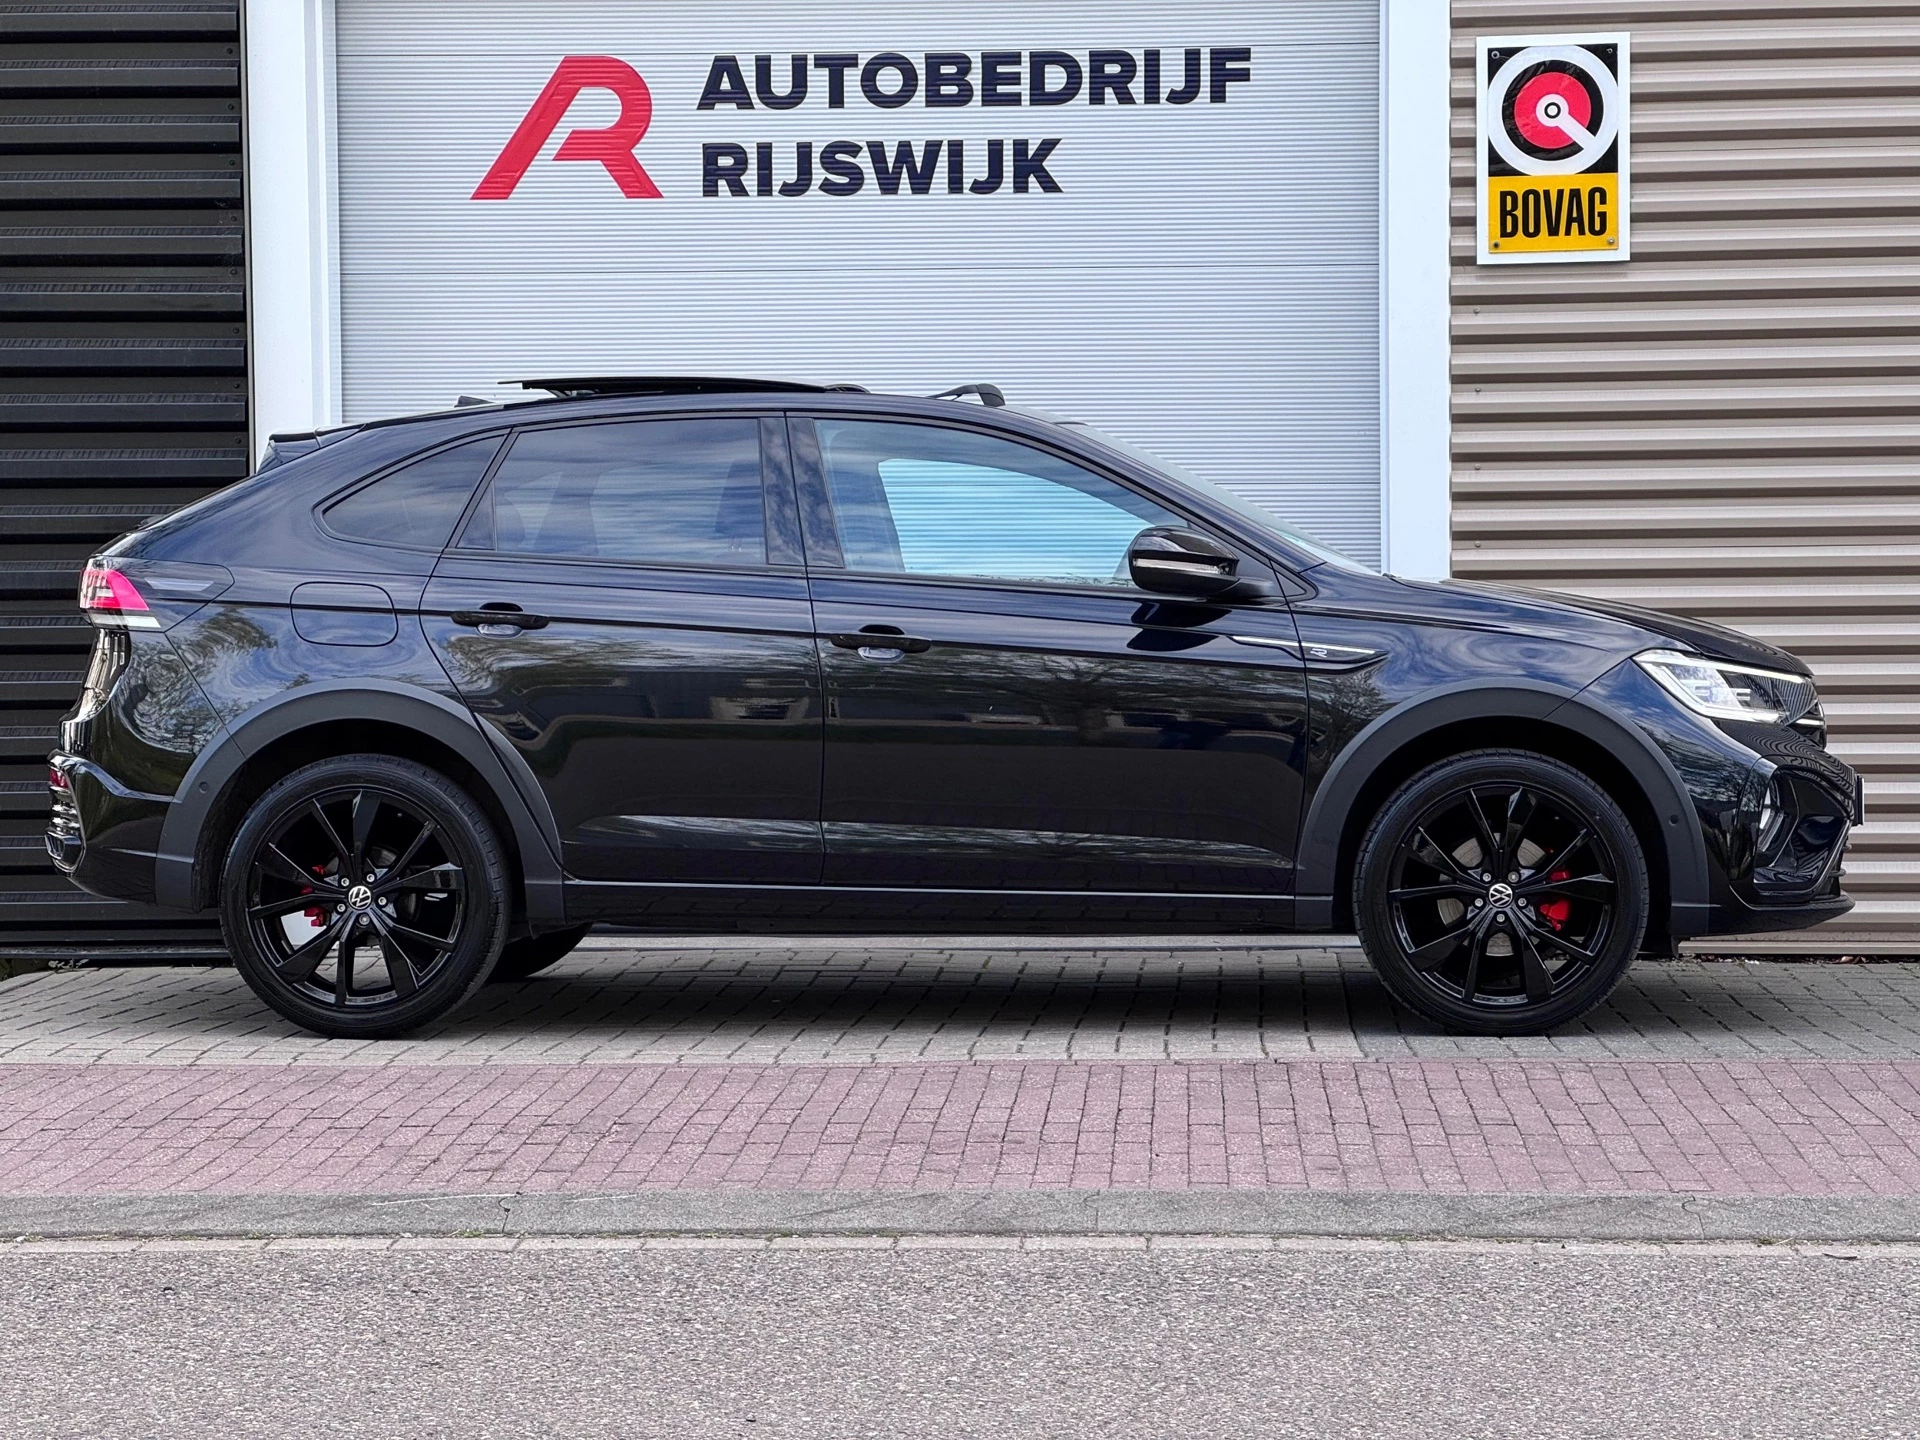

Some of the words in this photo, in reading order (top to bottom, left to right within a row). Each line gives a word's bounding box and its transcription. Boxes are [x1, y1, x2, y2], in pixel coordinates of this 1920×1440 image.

[697, 47, 1252, 111] AUTOBEDRIJF
[701, 138, 1065, 198] RIJSWIJK
[1499, 186, 1608, 238] BOVAG
